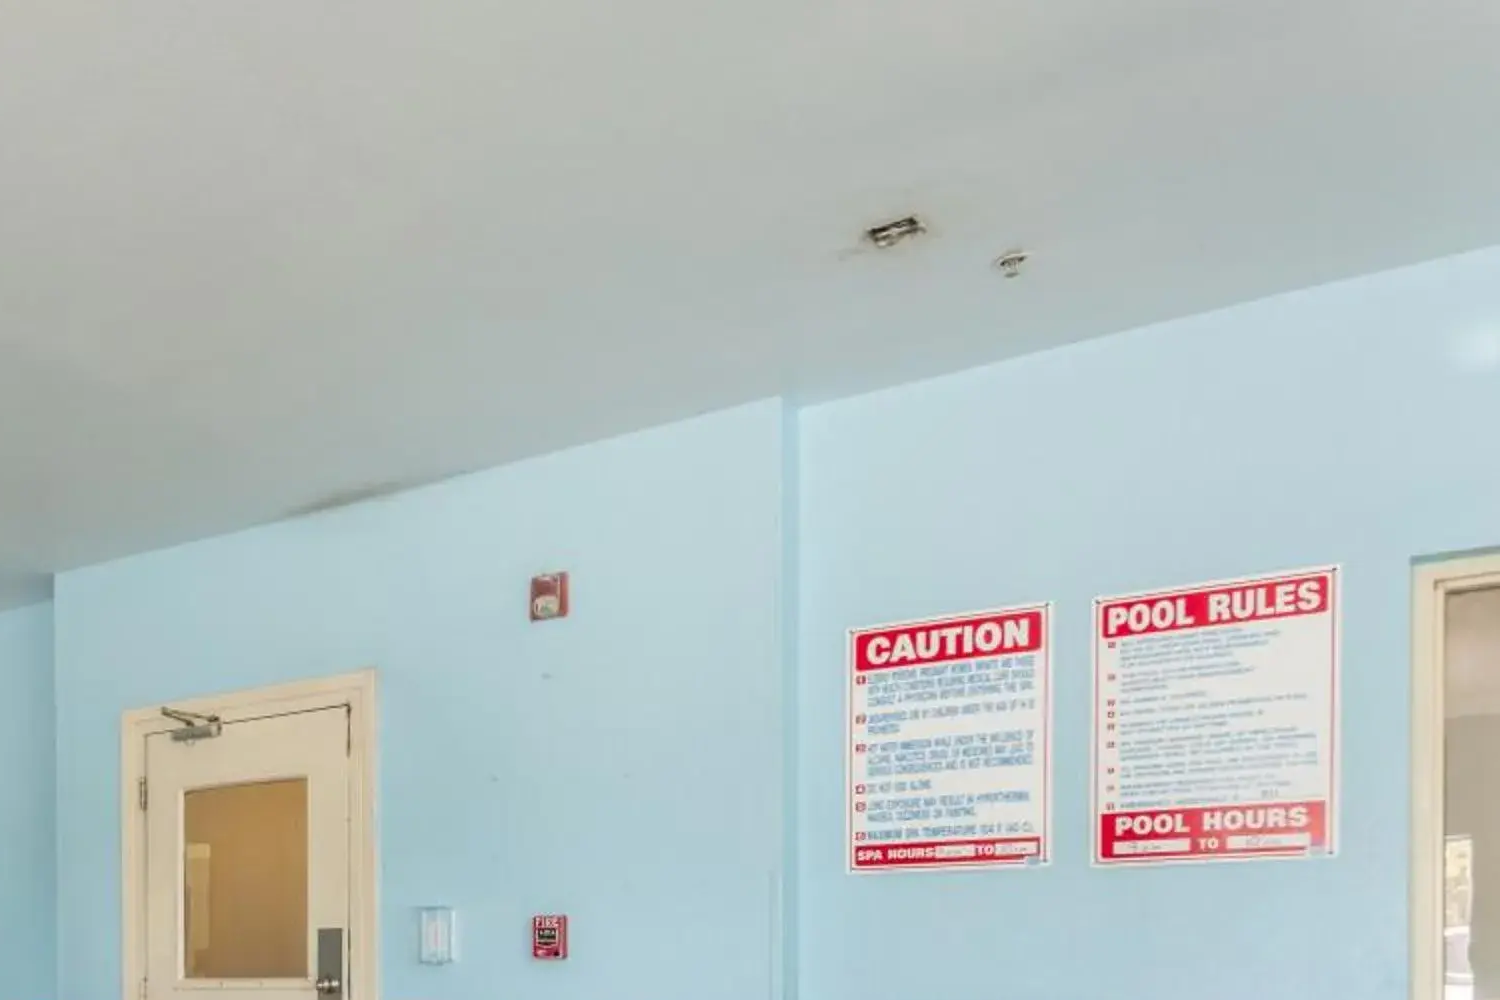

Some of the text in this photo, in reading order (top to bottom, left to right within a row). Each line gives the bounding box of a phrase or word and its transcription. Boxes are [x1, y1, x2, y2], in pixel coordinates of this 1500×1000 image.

[1106, 580, 1322, 635] POOL RULES
[866, 617, 1030, 665] CAUTION
[1114, 808, 1309, 836] POOL HOURS
[857, 848, 884, 861] SPA
[887, 846, 935, 860] HOURS
[976, 843, 995, 855] TO
[1197, 837, 1220, 850] TO
